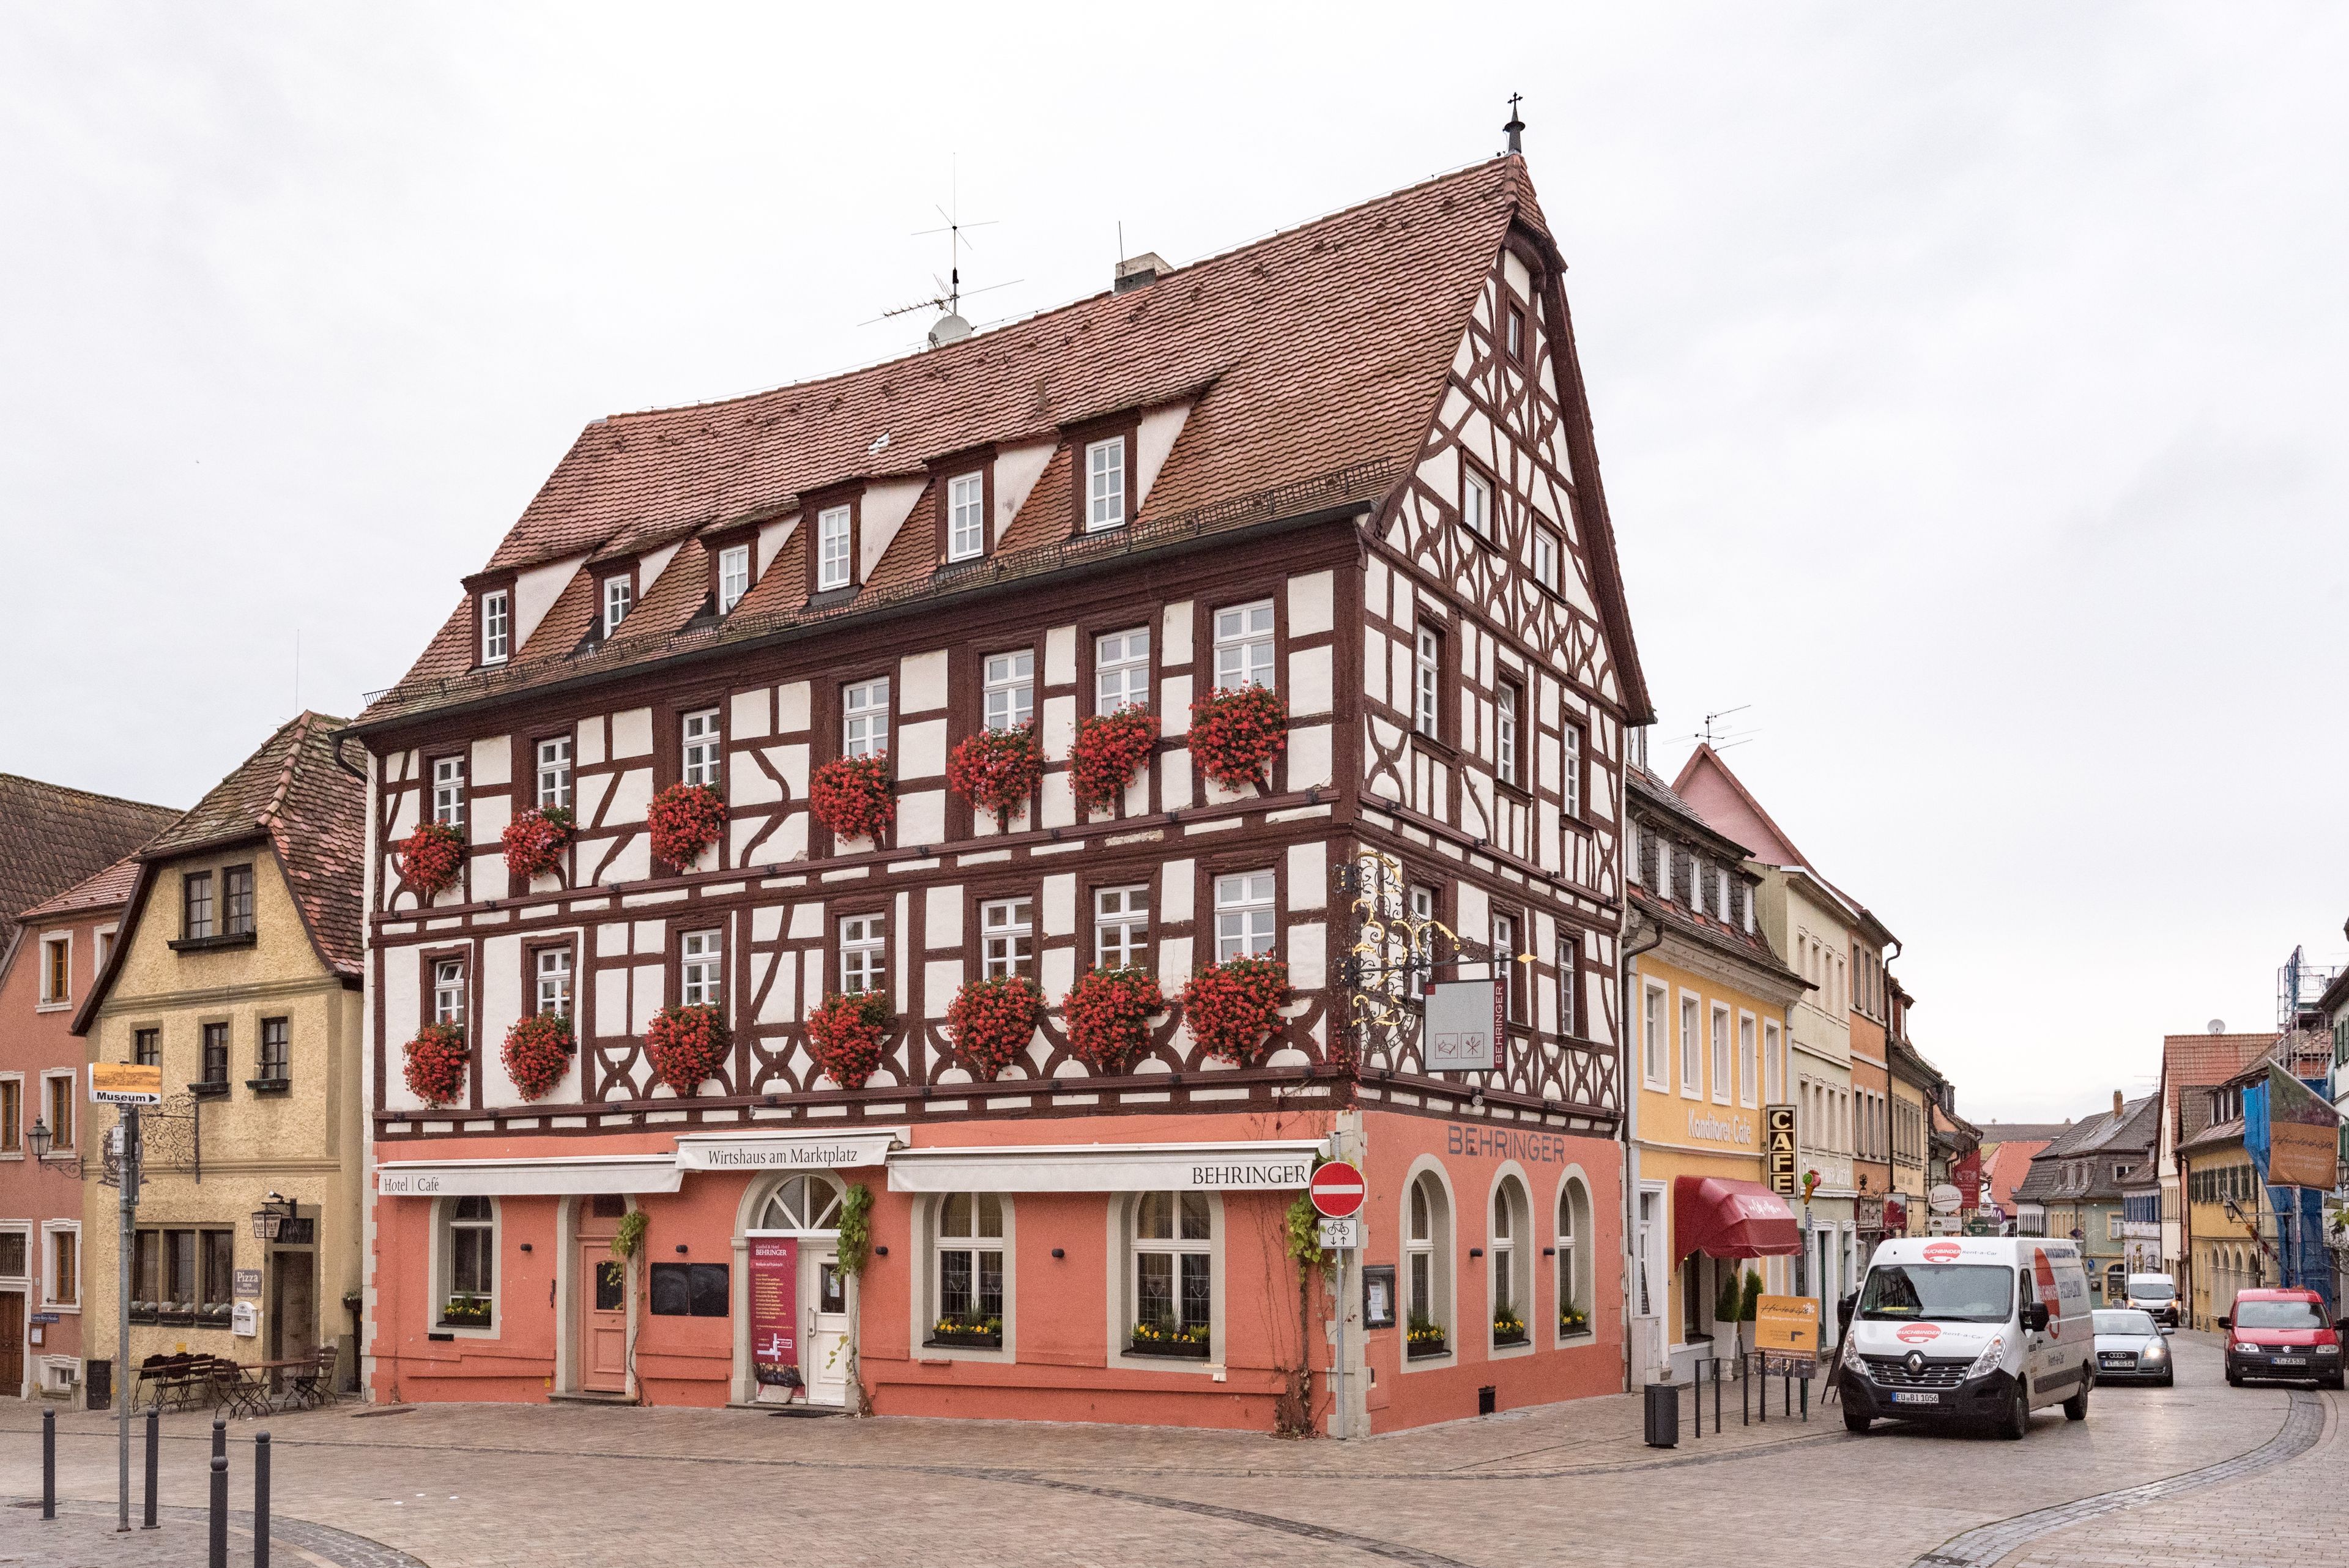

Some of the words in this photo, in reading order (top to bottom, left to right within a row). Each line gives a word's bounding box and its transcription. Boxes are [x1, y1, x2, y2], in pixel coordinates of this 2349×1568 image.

[1495, 986, 1504, 1064] BEHRINGER
[97, 1091, 146, 1102] Museum
[1448, 1125, 1565, 1164] BEHRINGER
[1771, 1111, 1793, 1194] CAFE
[708, 1148, 766, 1164] Wirtshaus
[769, 1153, 786, 1164] am
[790, 1146, 858, 1167] Marktplatz
[384, 1177, 407, 1191] Hotel
[418, 1176, 439, 1191] Café
[1192, 1165, 1307, 1184] BEHRINGER
[237, 1272, 258, 1282] Pizza
[1942, 1331, 1984, 1340] Rent-a-Car
